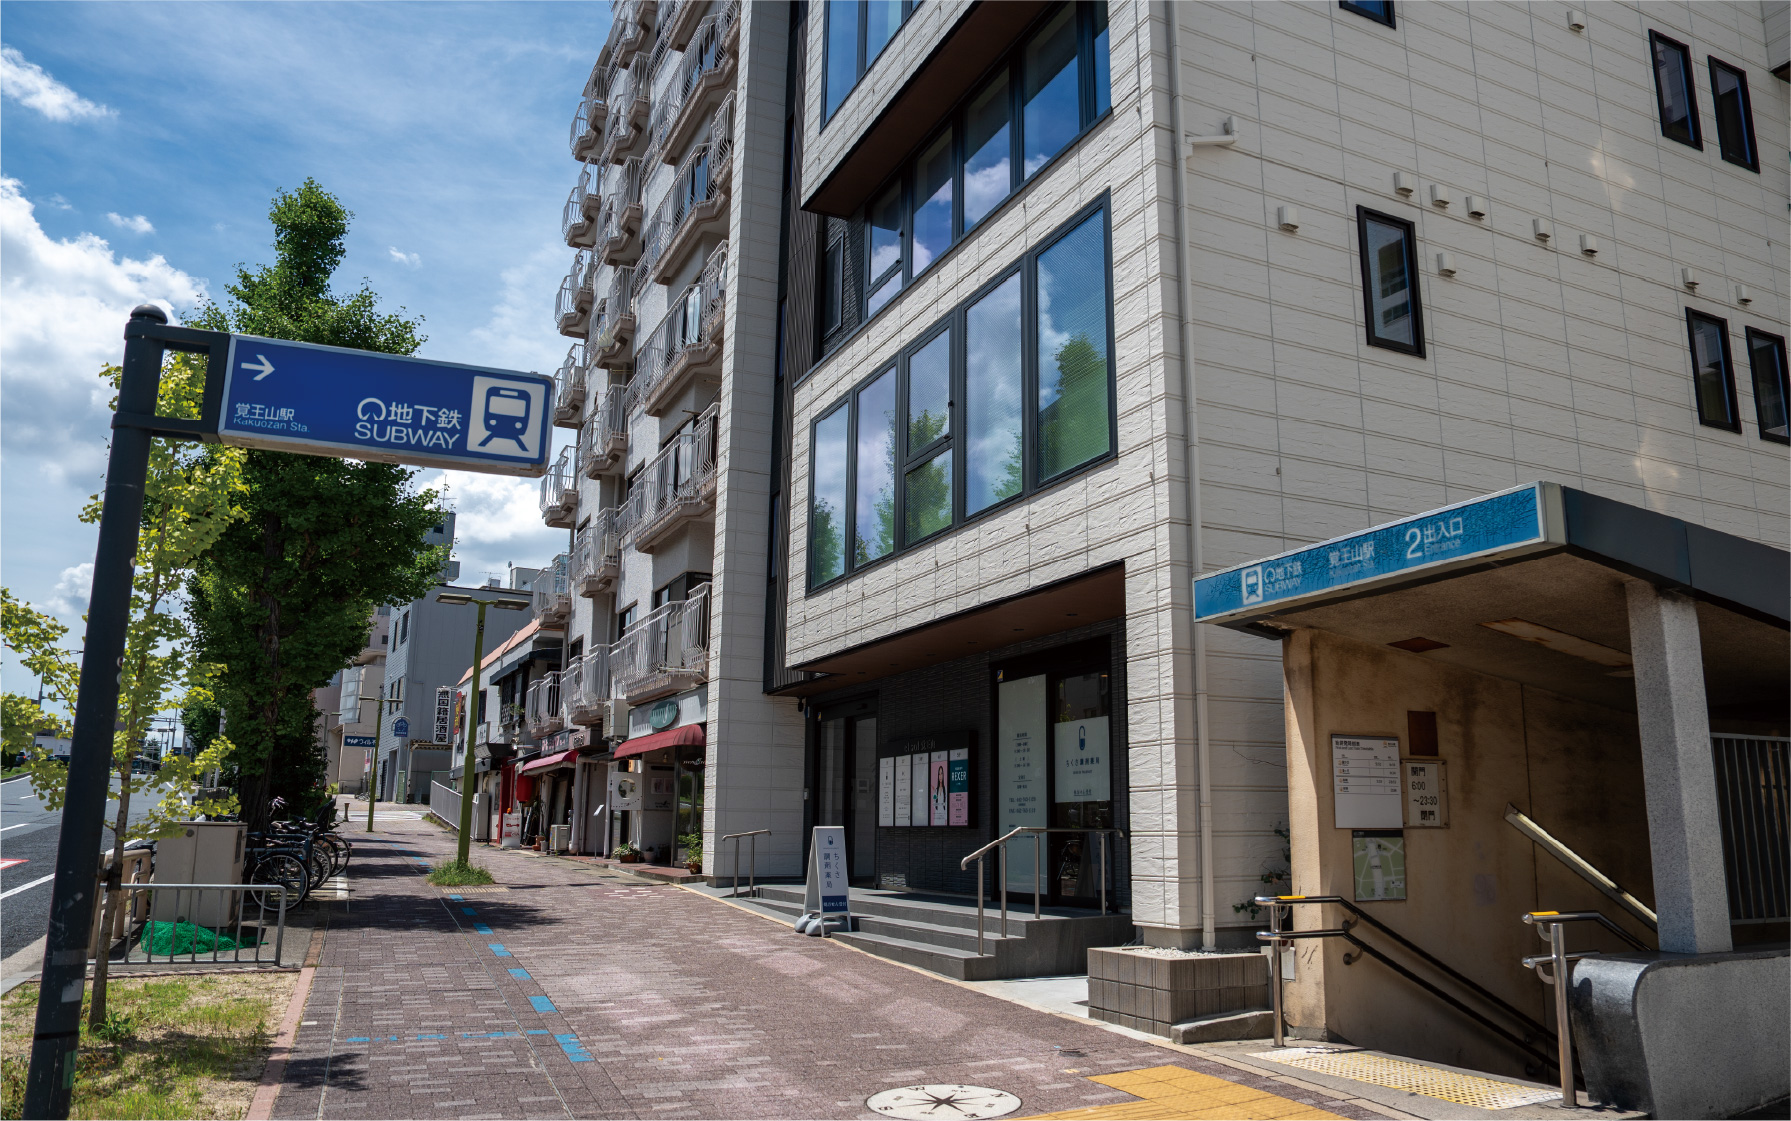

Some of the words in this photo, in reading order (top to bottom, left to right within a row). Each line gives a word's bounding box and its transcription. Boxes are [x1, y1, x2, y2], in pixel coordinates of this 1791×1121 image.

[234, 402, 295, 421] 覚王山駅
[388, 401, 462, 430] 地下鉄
[233, 417, 287, 430] Kakuozan
[290, 421, 310, 433] Sta.
[354, 421, 461, 450] SUBWAY
[1405, 528, 1423, 559] 2
[1424, 517, 1463, 544] 出入口
[1328, 541, 1375, 567] 覚王山駅
[1424, 539, 1461, 555] Entrance
[1275, 561, 1302, 579] 地下鉄
[1264, 577, 1302, 594] SUBWAY
[435, 690, 450, 743] 無国籍居酒屋
[1411, 781, 1426, 791] 6:00
[823, 852, 832, 889] 調剤薬局
